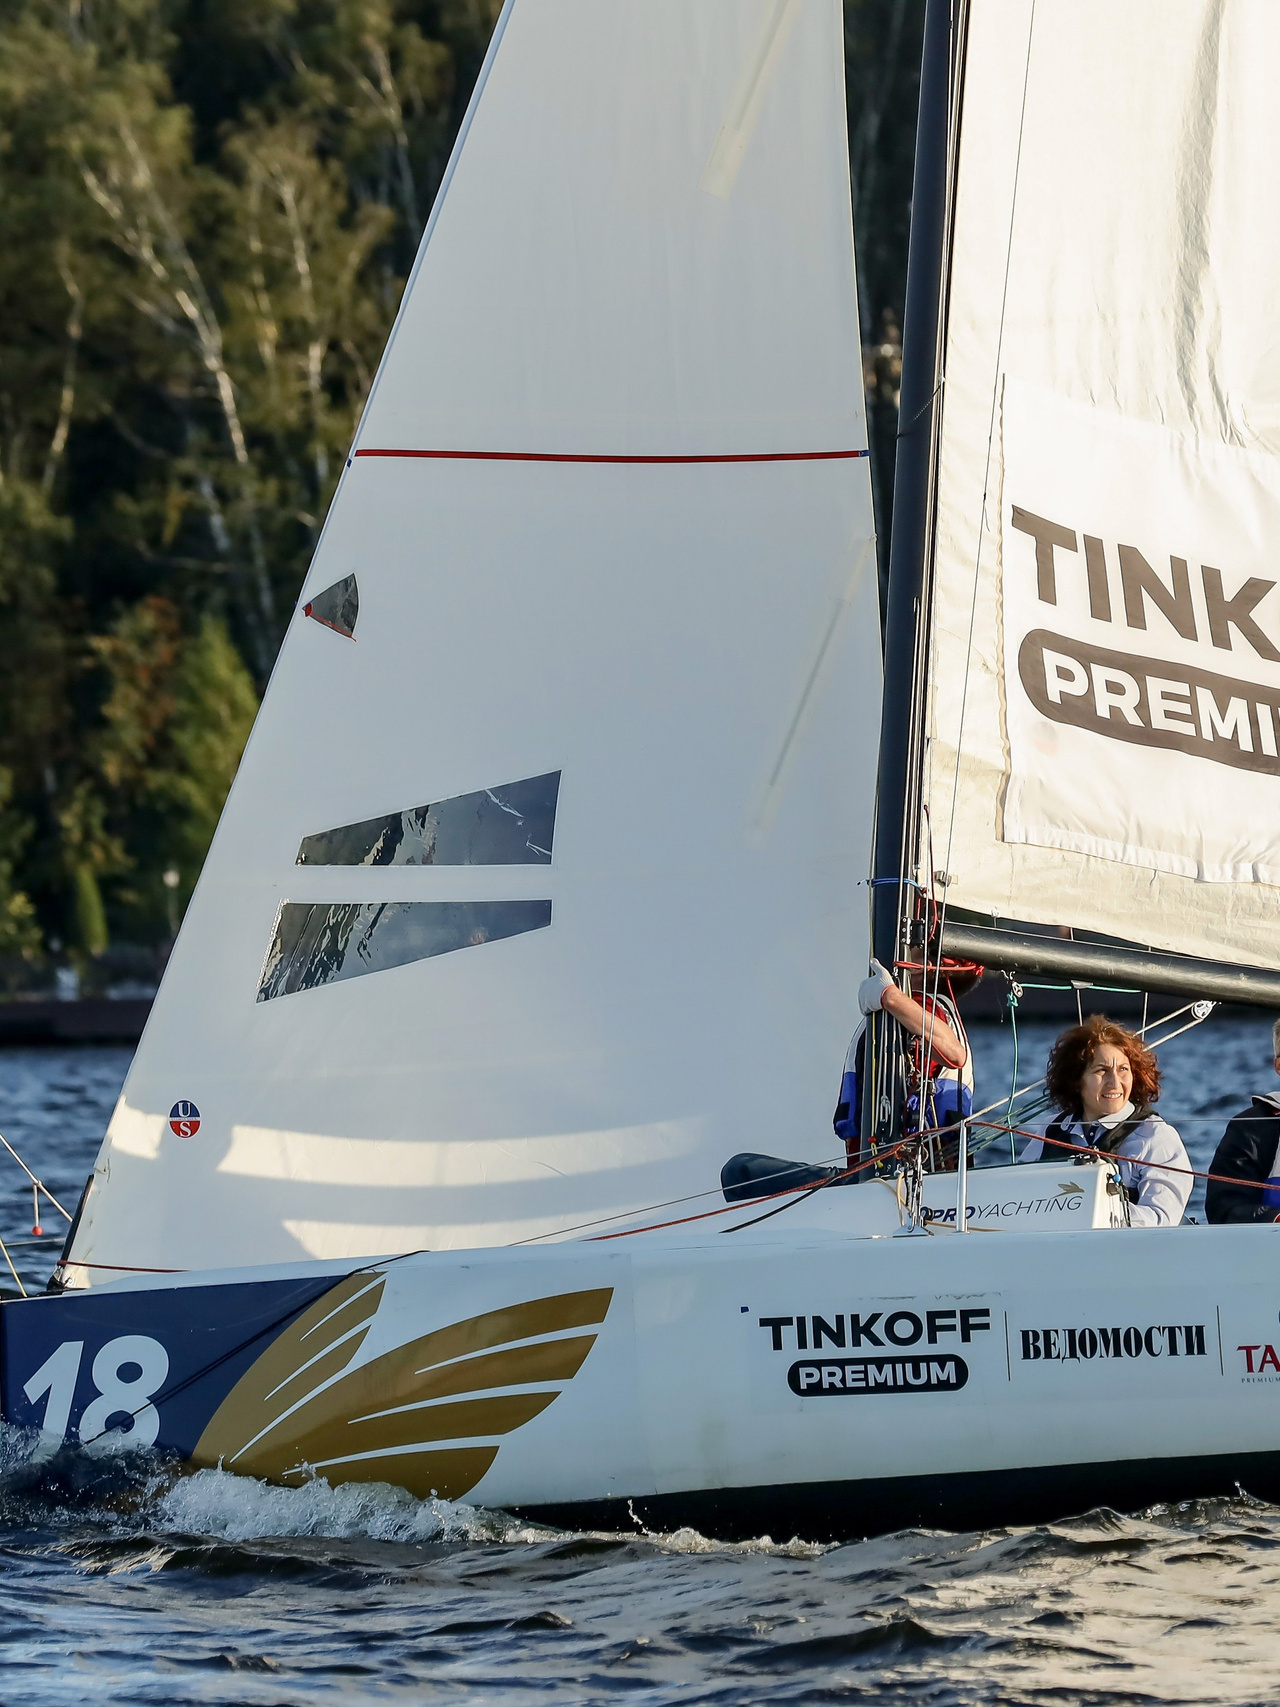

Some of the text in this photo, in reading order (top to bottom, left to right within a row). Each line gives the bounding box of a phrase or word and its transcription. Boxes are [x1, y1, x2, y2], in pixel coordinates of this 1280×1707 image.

[759, 1308, 991, 1351] TINKOFF
[1020, 1324, 1208, 1364] ВЕДОМОСТИ
[799, 1360, 957, 1390] PREMIUM
[23, 1335, 170, 1463] 18
